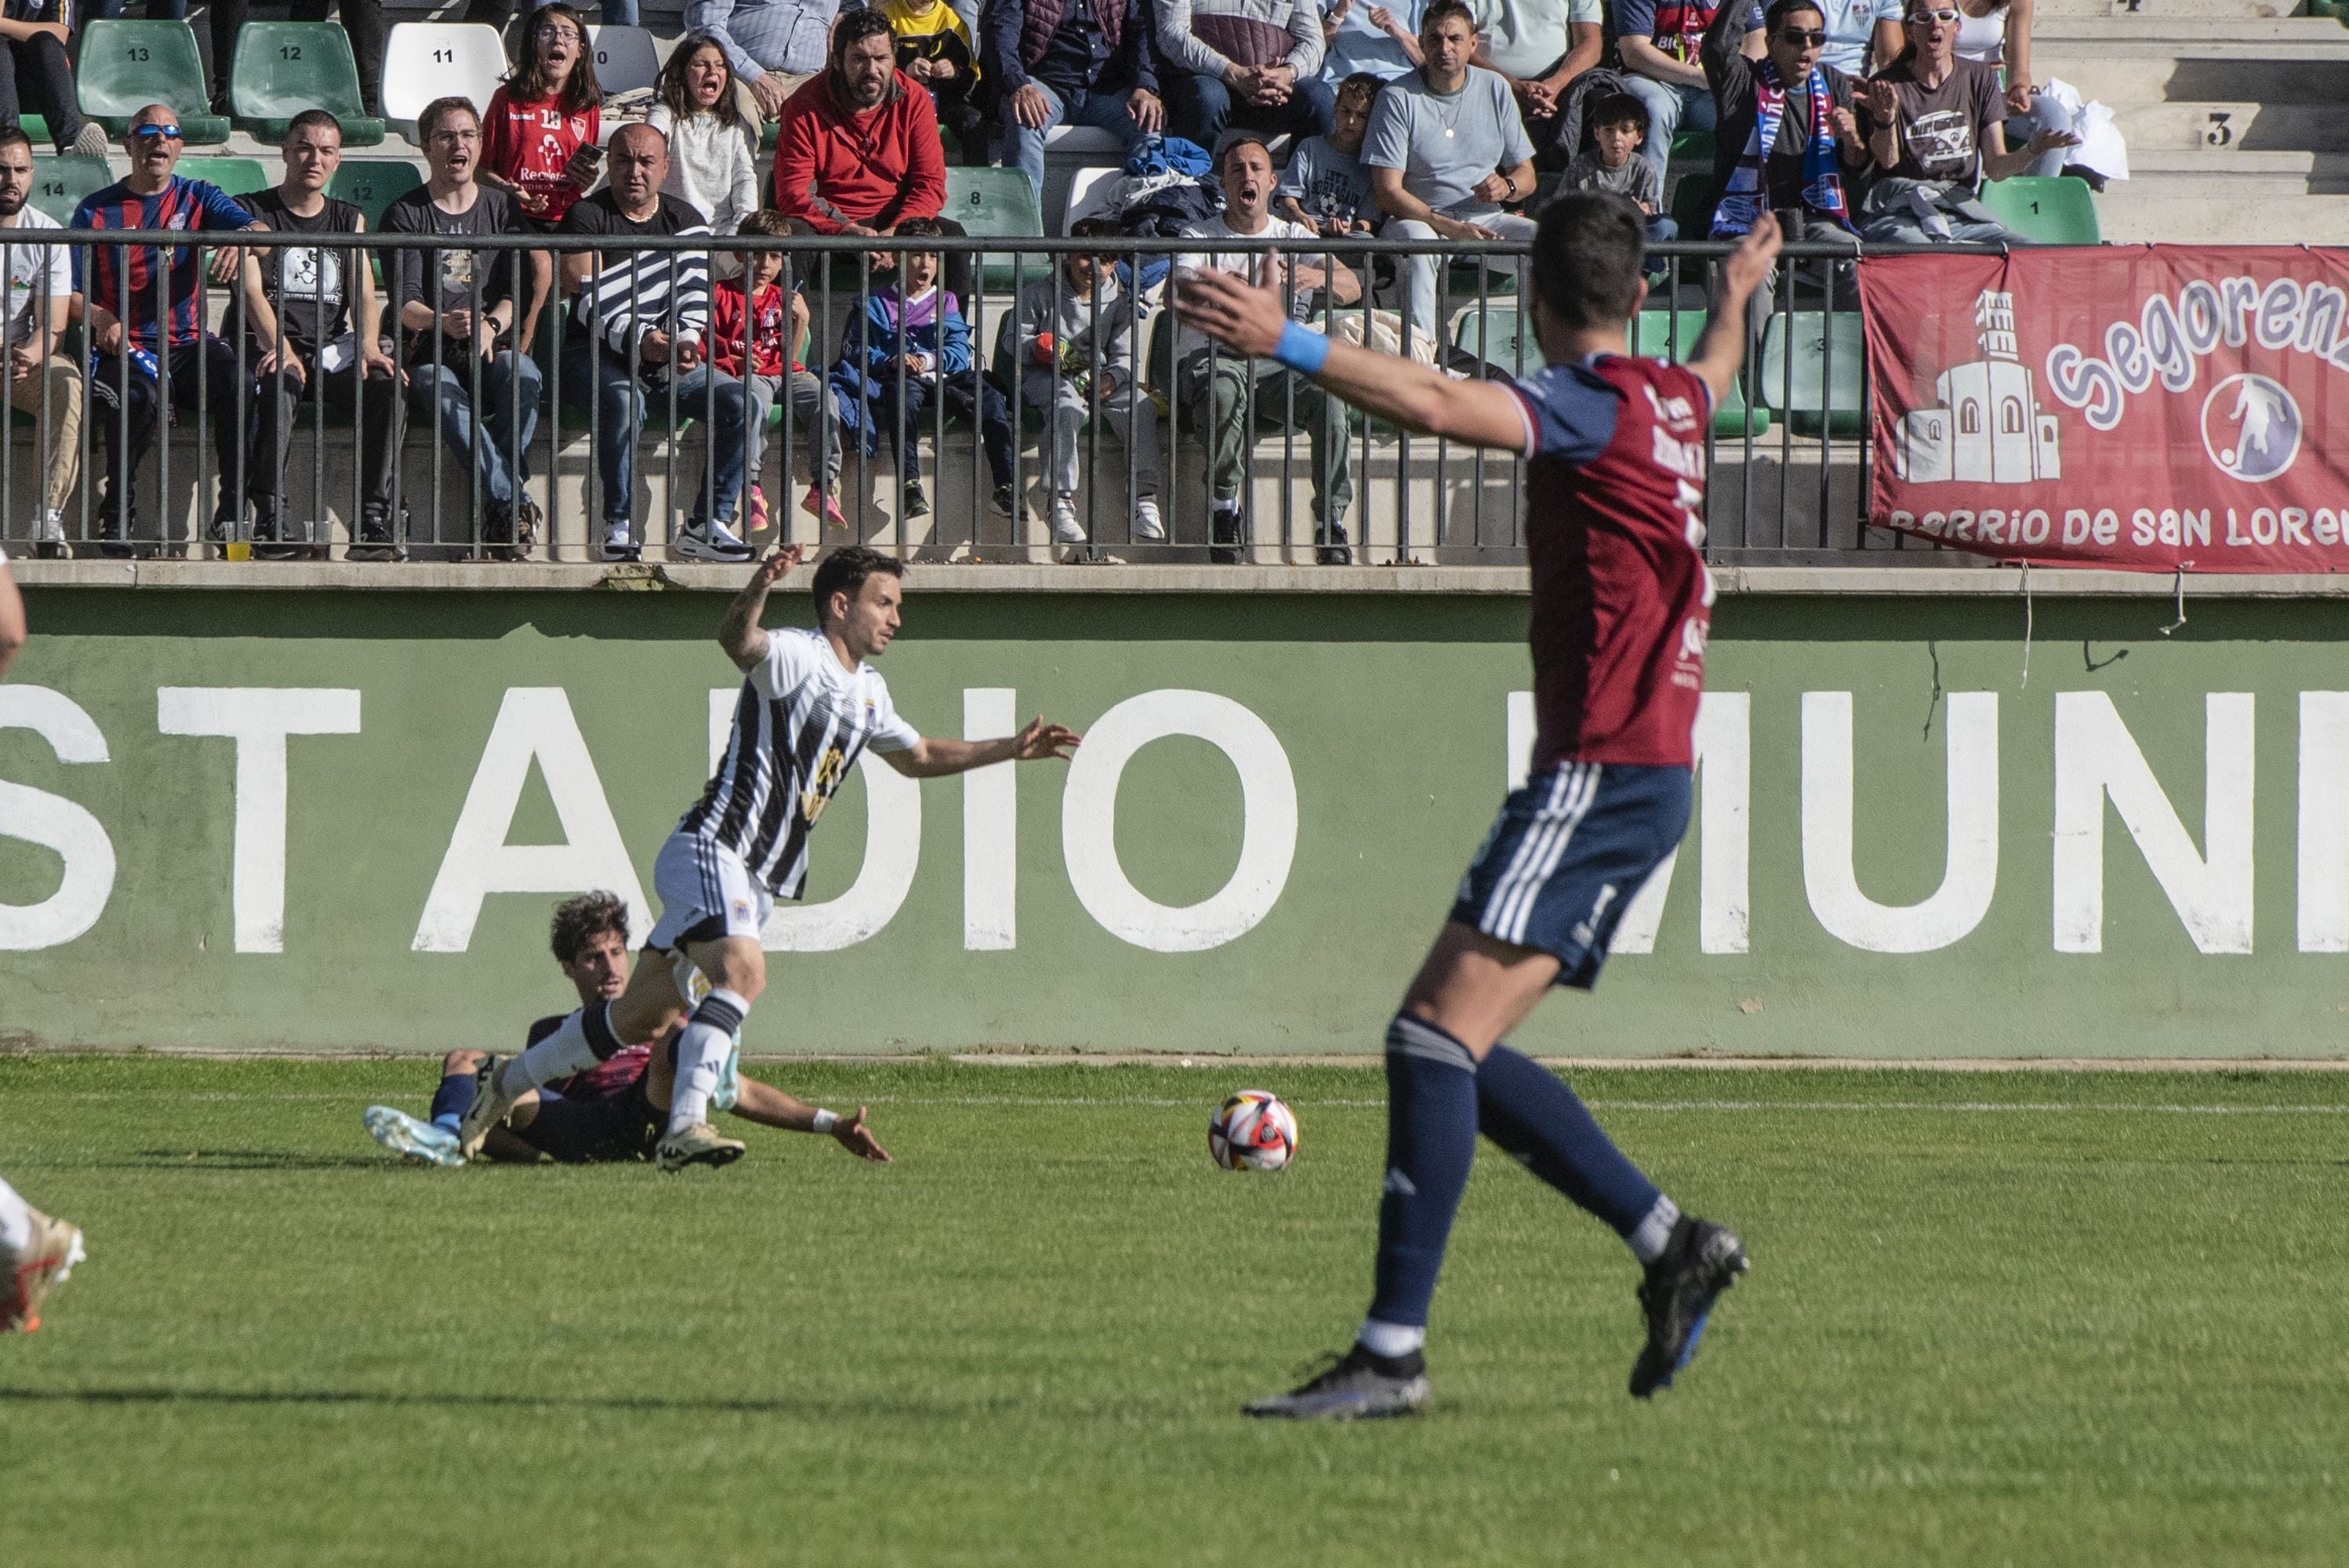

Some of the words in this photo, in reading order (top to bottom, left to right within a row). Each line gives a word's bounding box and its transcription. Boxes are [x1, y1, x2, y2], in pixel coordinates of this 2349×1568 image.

[128, 48, 150, 62] 13
[280, 46, 301, 60] 12
[433, 49, 452, 63] 11
[592, 50, 608, 64] 0
[540, 109, 561, 130] 18
[2207, 113, 2232, 146] 3
[42, 183, 64, 197] 14
[351, 187, 373, 201] 12
[971, 191, 981, 205] 8
[2031, 201, 2039, 215] 1
